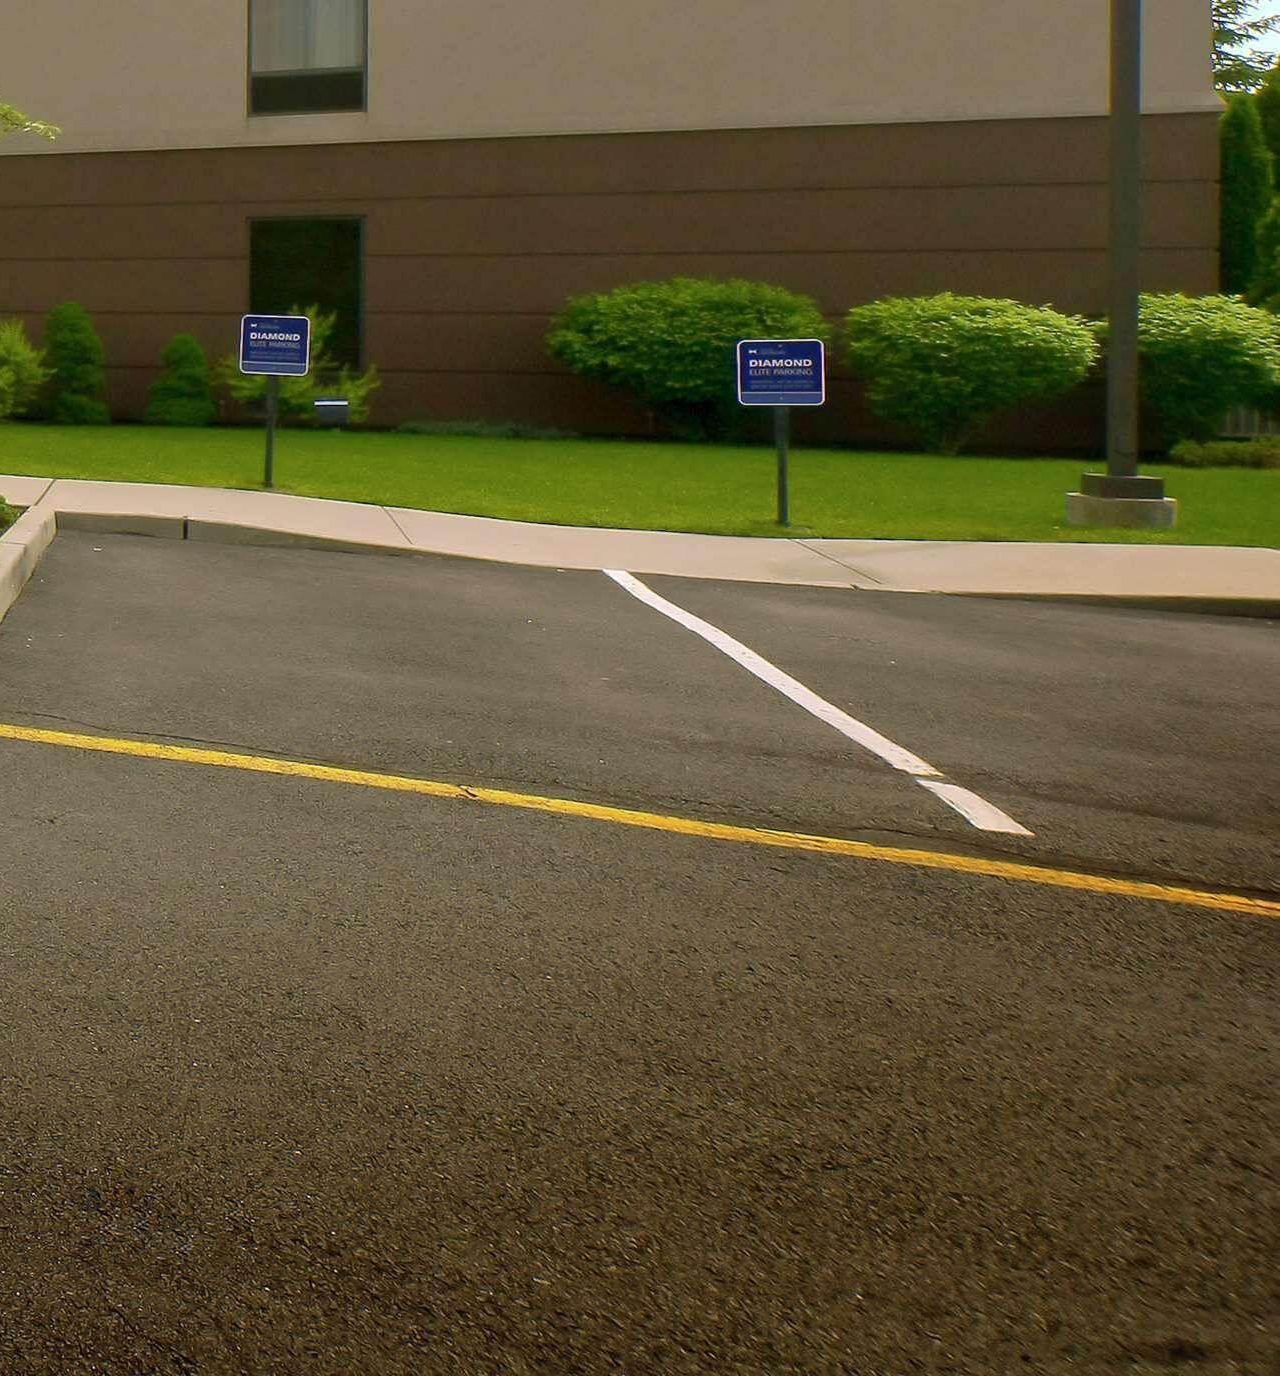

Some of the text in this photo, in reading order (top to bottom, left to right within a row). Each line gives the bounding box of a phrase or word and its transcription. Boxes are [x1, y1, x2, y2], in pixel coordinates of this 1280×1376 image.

[250, 332, 301, 341] DIAMOND
[749, 359, 813, 368] DIAMOND
[749, 368, 813, 376] ELITE PARKING
